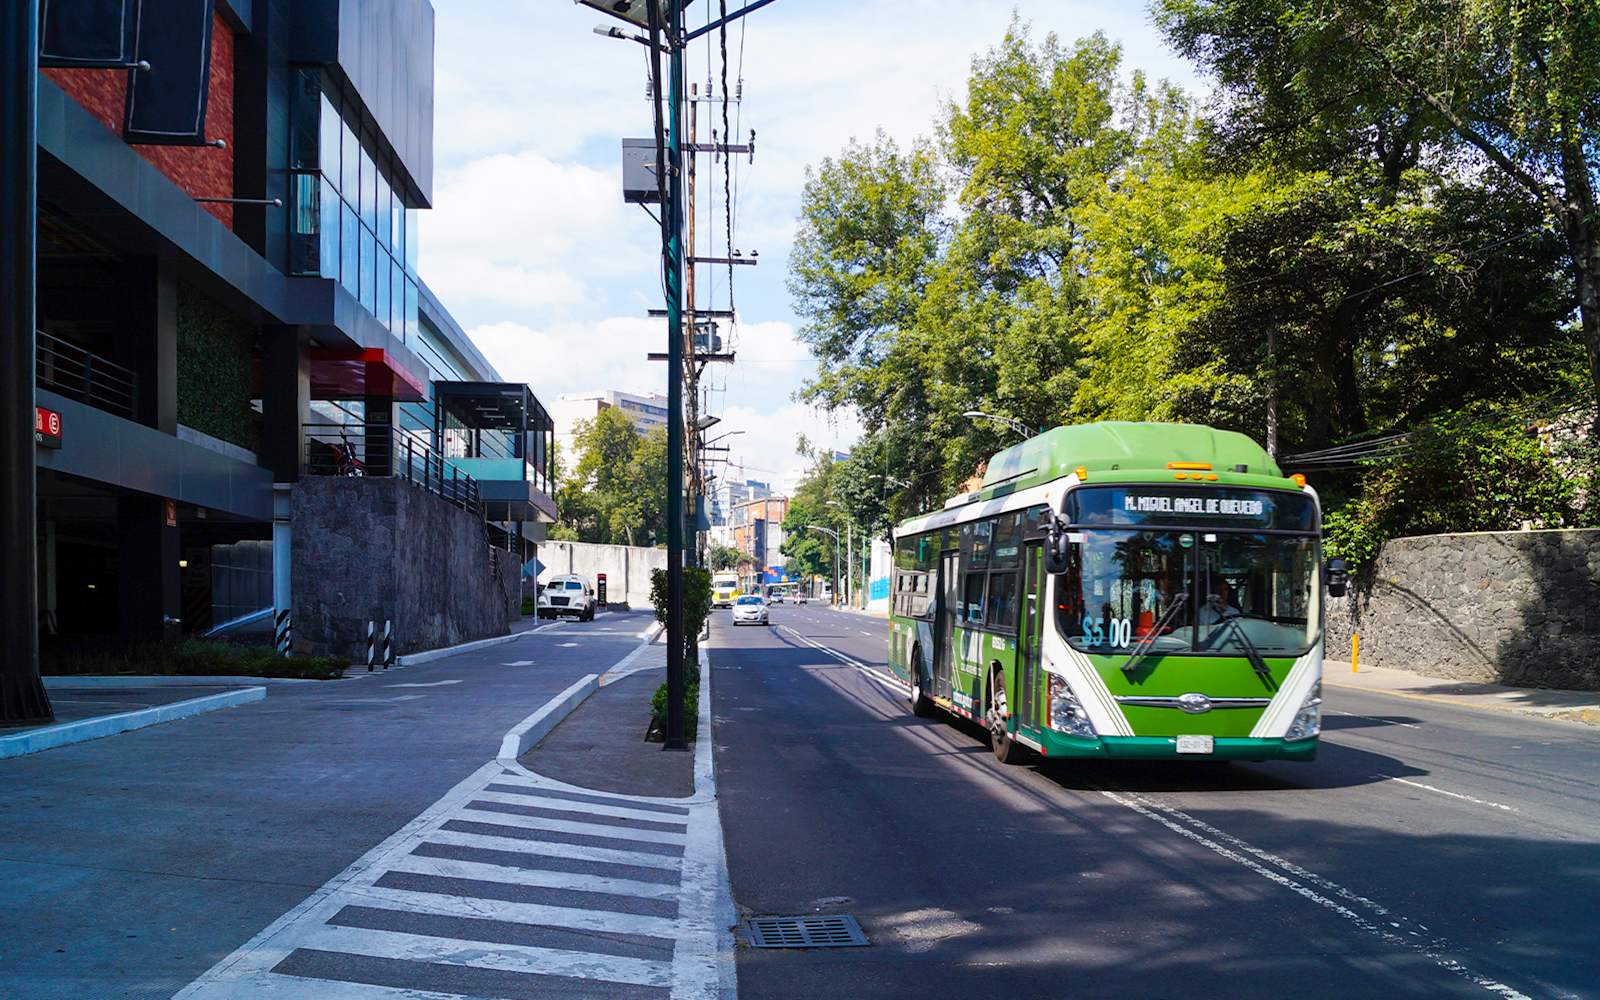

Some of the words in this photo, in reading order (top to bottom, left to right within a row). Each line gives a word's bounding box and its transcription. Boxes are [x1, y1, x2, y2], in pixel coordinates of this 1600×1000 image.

[1138, 497, 1173, 512] MIGUEL
[1174, 498, 1205, 513] ANGEL
[1206, 499, 1219, 513] DE
